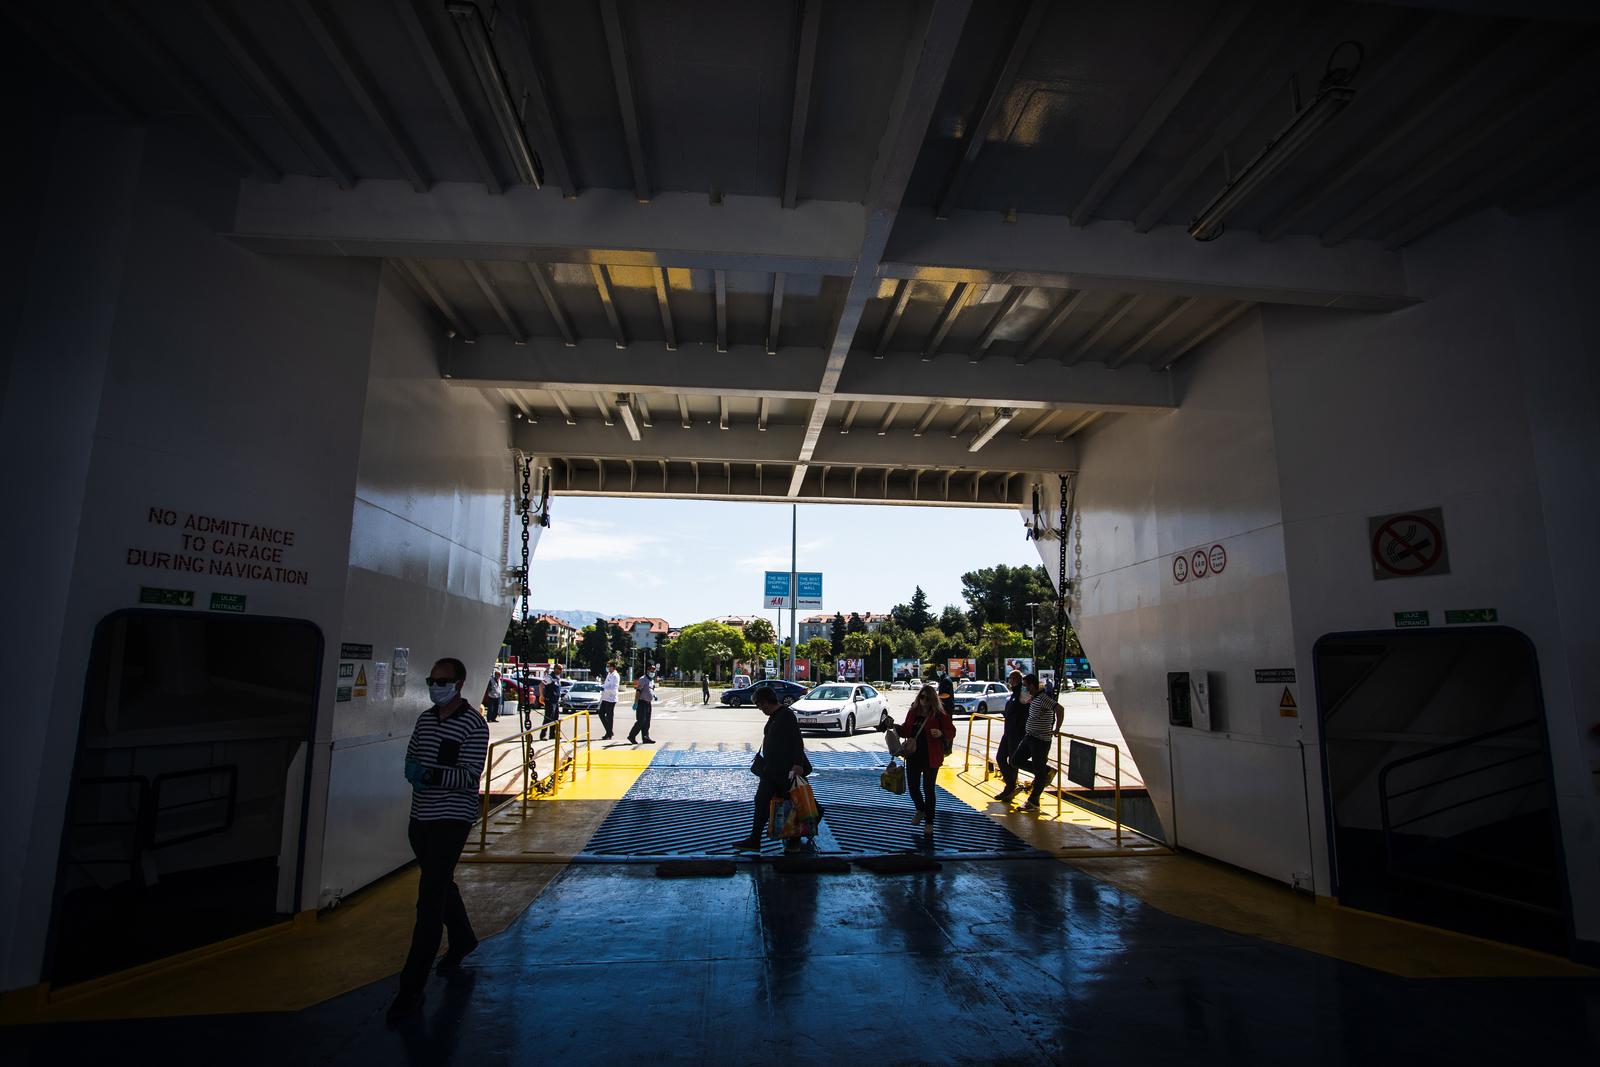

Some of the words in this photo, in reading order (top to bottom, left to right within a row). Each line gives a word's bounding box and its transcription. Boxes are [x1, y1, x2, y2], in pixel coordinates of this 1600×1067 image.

[148, 507, 177, 526] NO
[184, 514, 295, 547] ADMITTANCE
[181, 533, 206, 552] TO
[212, 539, 284, 563] GARAGE
[126, 547, 204, 573] DURING
[208, 559, 308, 585] NAVIGATION
[211, 602, 245, 612] ENTRANCE
